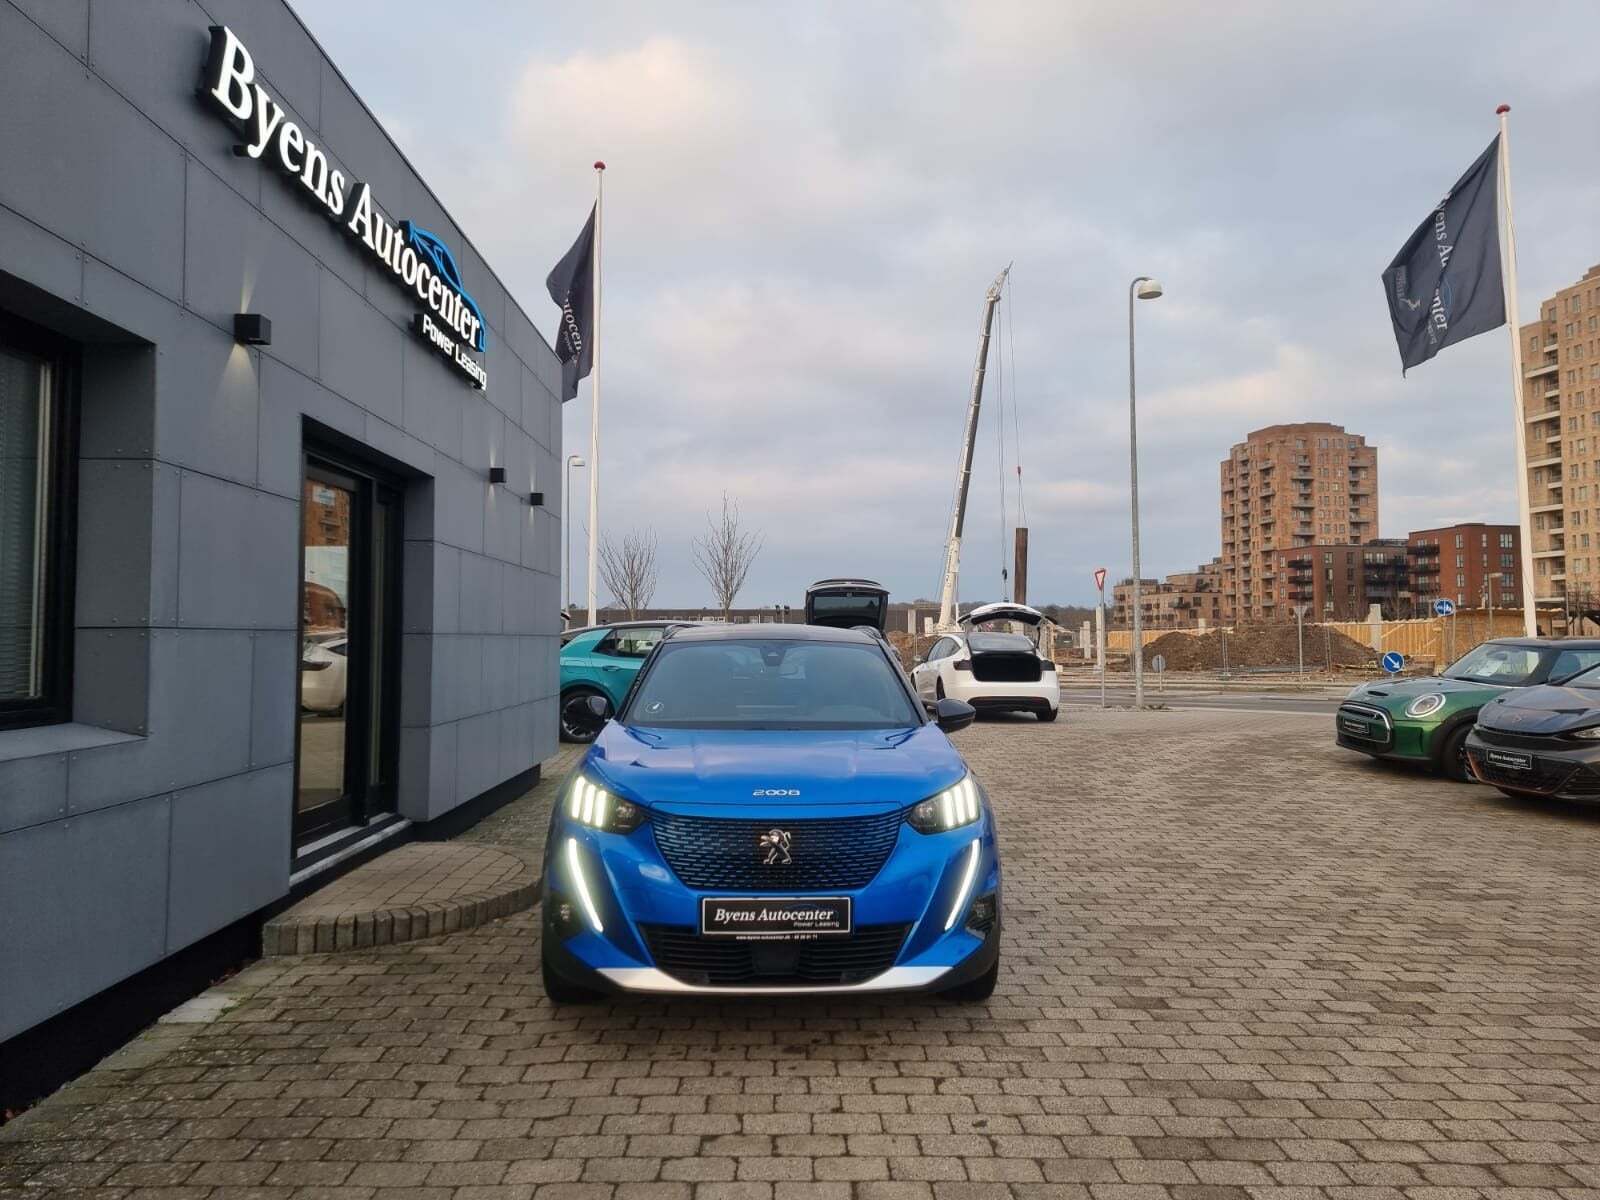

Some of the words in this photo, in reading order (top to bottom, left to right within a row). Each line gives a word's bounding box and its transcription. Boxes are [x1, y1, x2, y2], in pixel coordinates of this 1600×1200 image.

[211, 26, 345, 215] Byens
[348, 183, 480, 348] Autocenter
[422, 314, 455, 356] Power
[455, 344, 487, 391] Leasing
[714, 908, 756, 924] Byens
[757, 908, 834, 921] Autocenter
